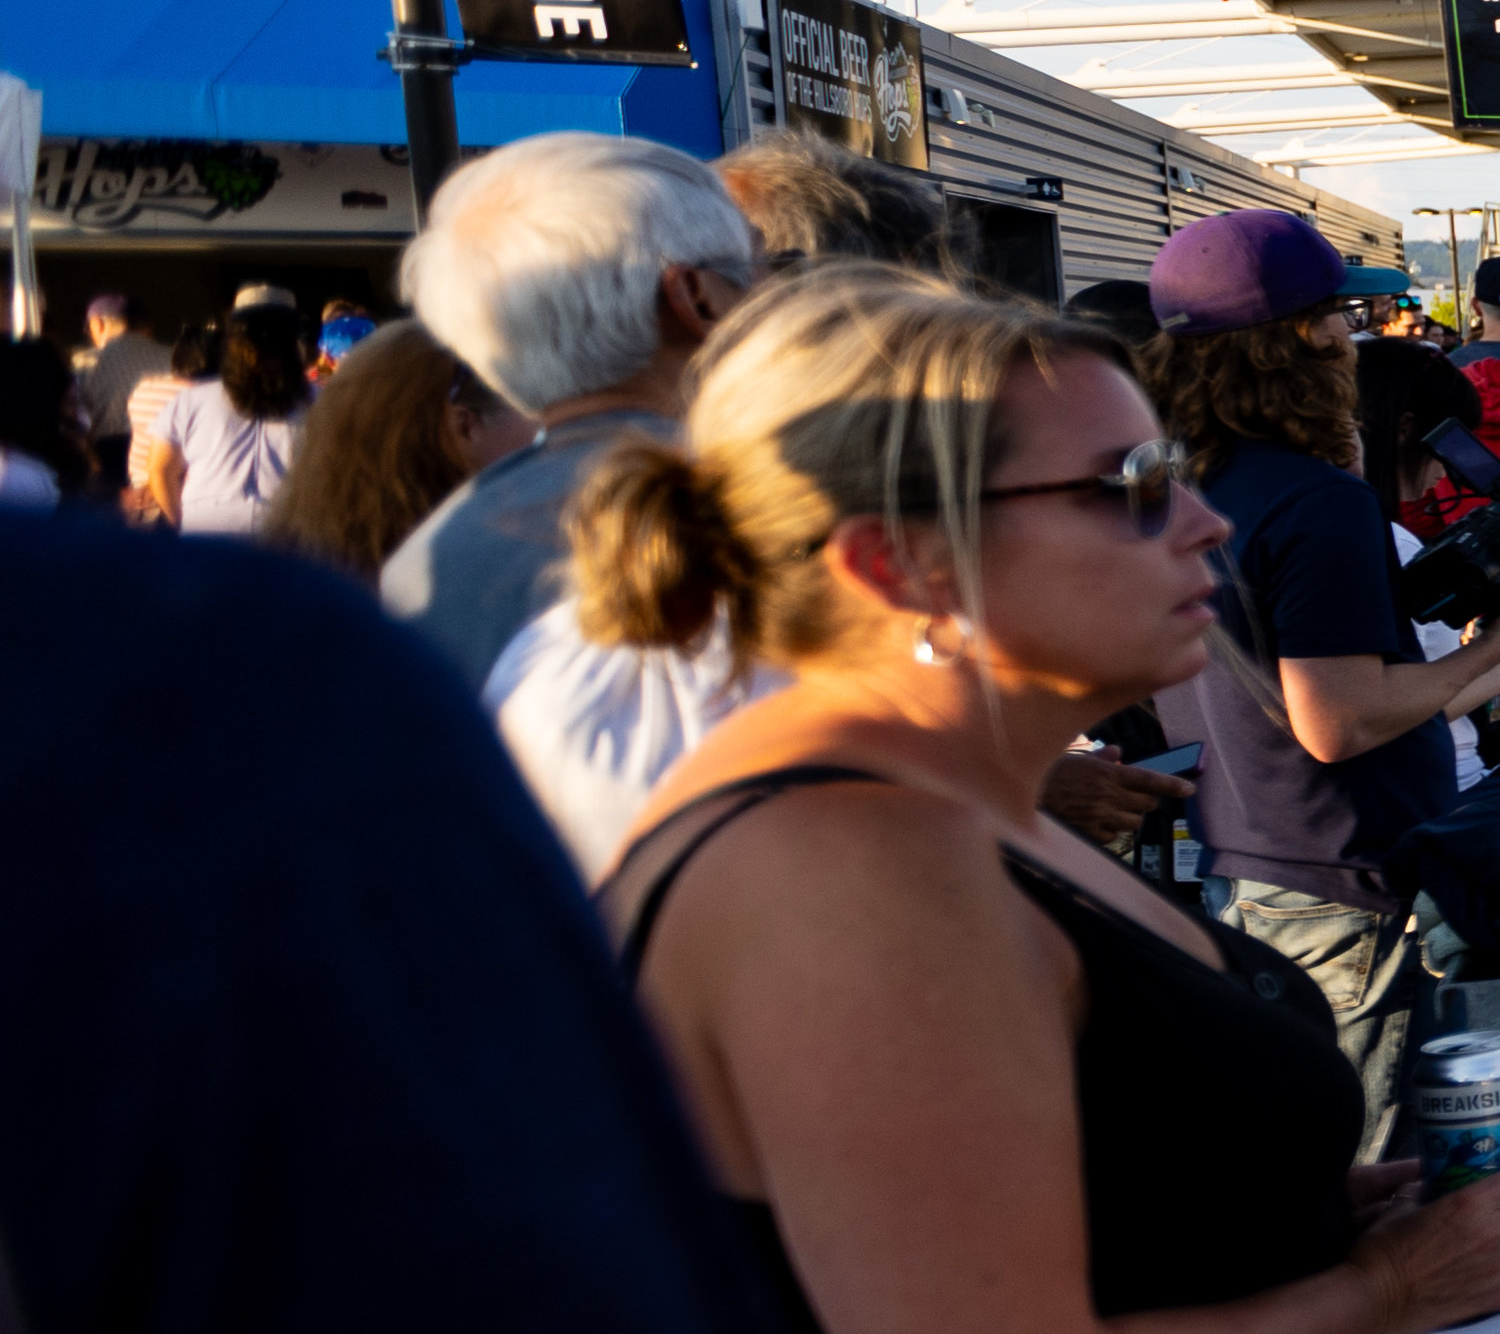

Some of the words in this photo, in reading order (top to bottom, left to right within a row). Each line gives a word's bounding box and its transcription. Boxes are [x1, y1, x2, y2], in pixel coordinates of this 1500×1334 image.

[782, 8, 839, 78] OFFICIAL
[838, 28, 871, 88] BEER
[786, 71, 798, 104] OF
[798, 74, 814, 109] THE
[34, 141, 223, 228] Hops
